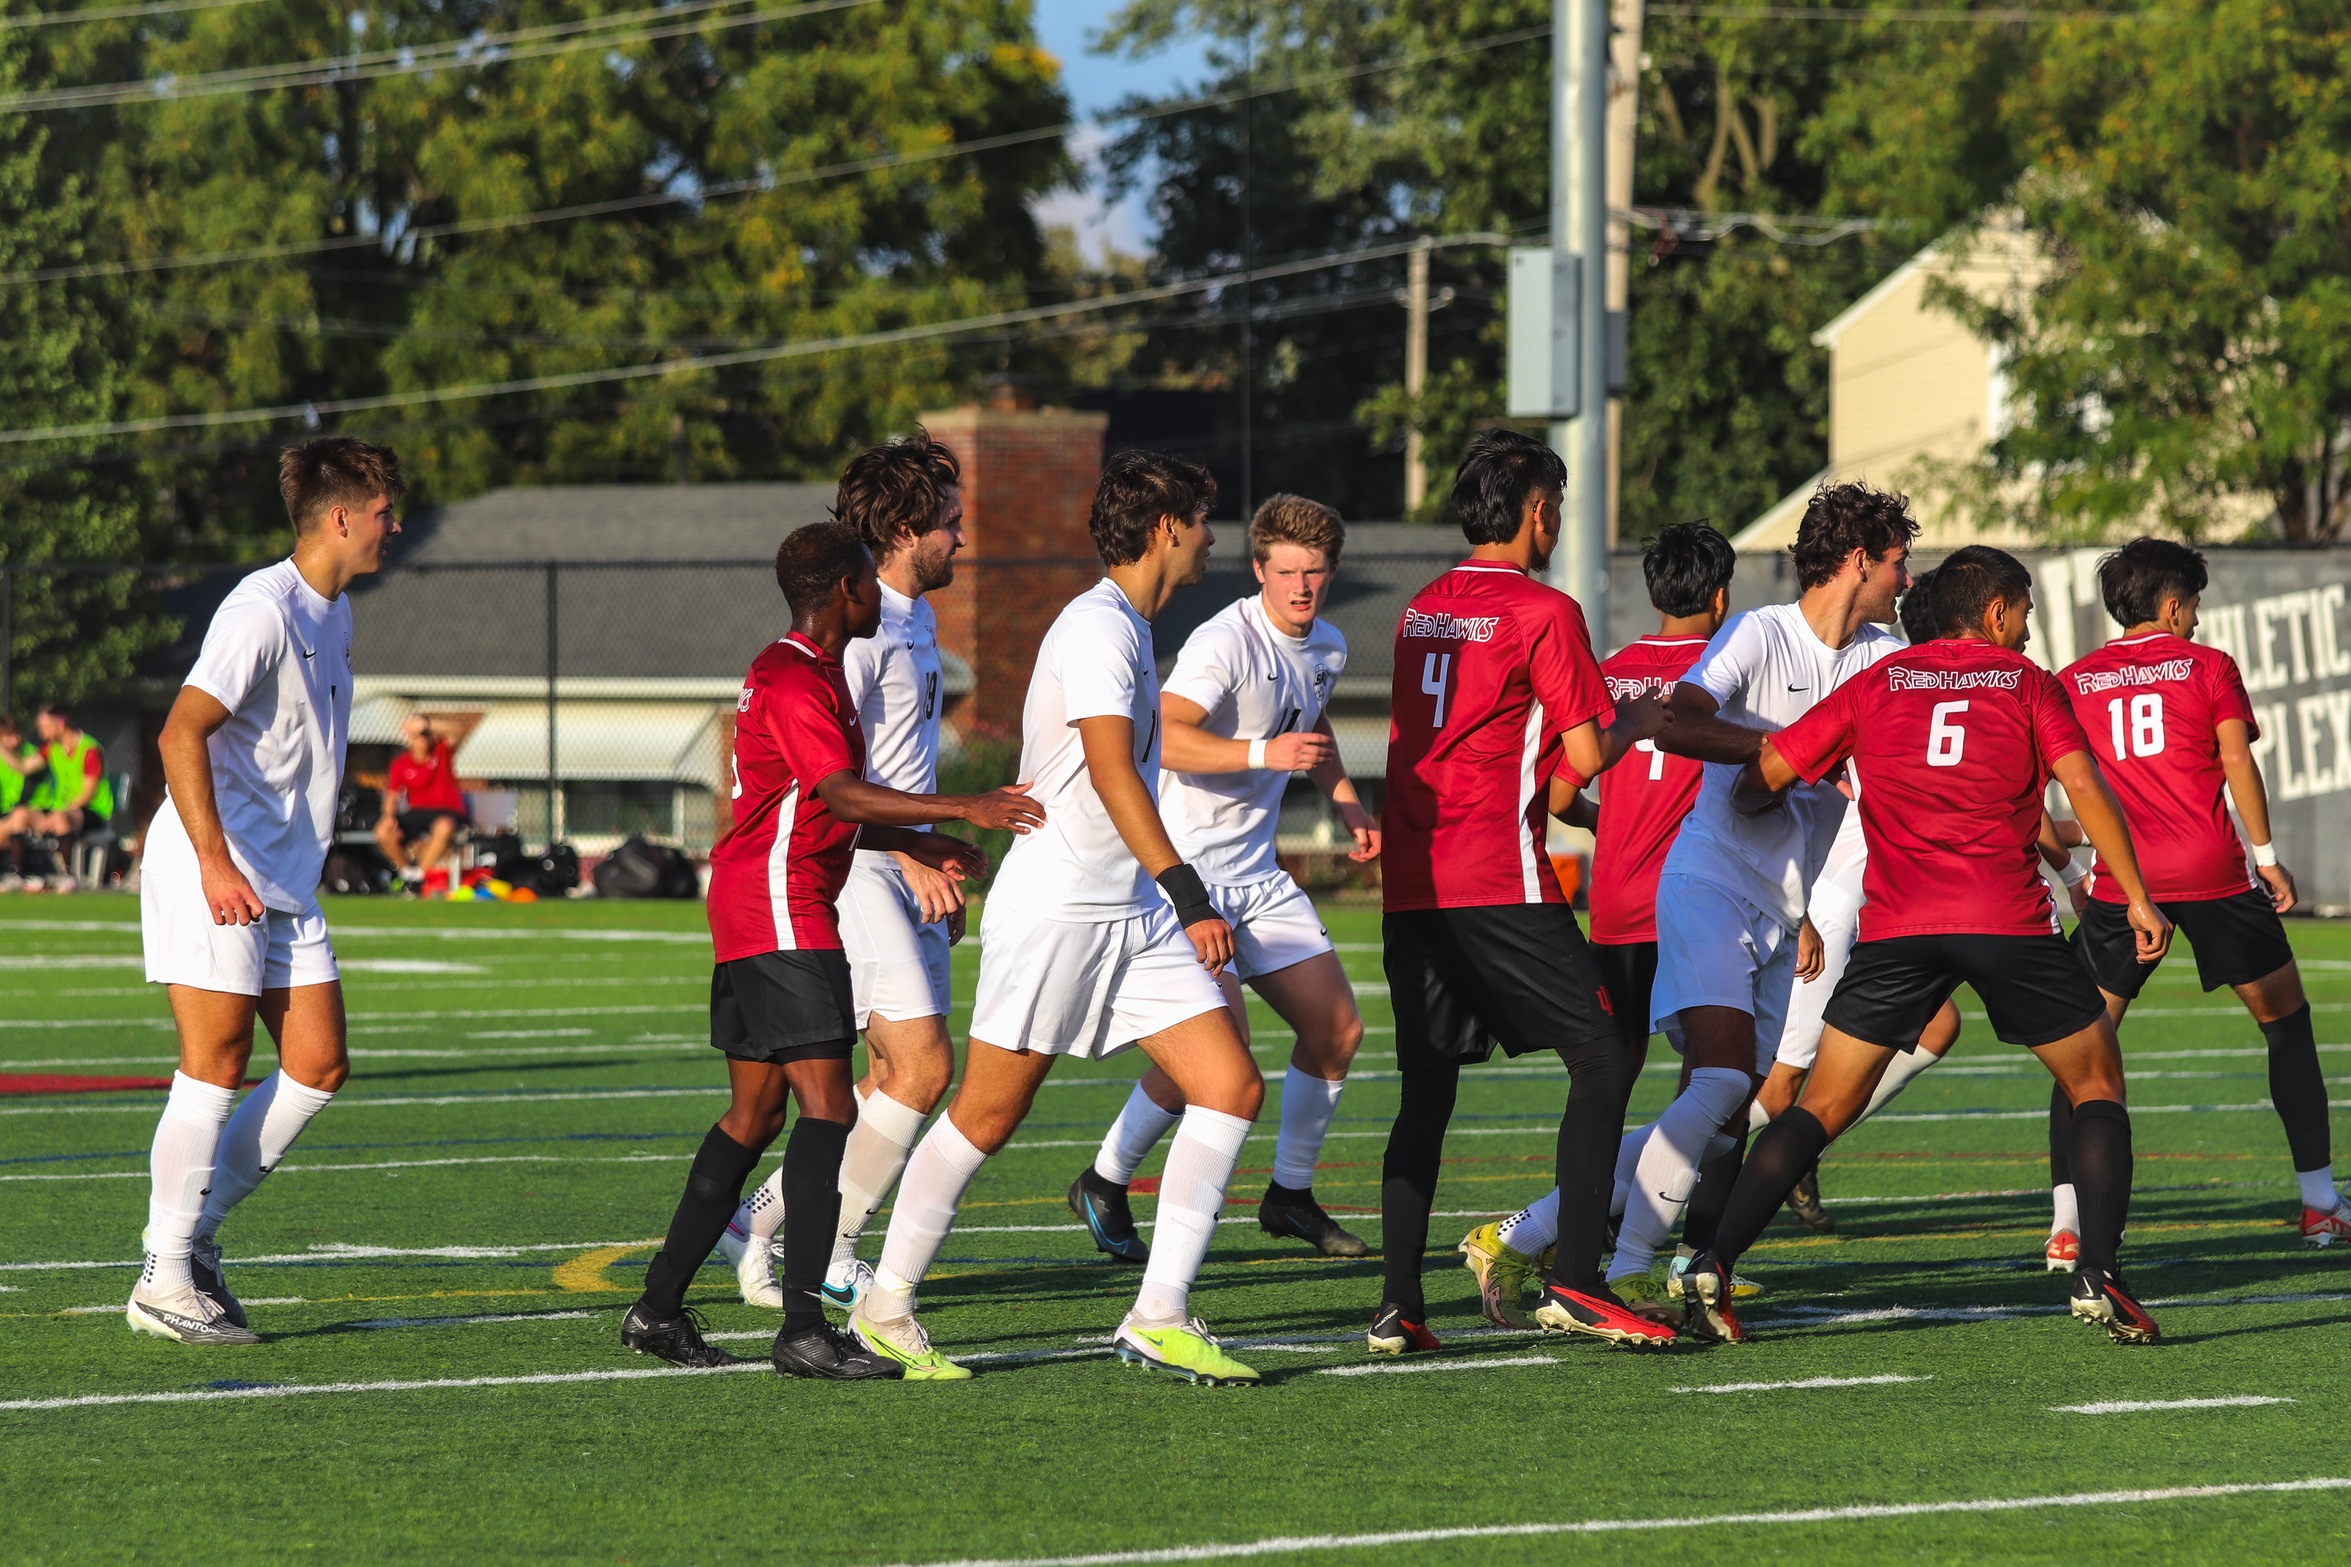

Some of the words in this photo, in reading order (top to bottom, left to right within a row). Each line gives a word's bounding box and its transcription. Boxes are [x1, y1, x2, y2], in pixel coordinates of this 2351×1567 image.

[1421, 652, 1451, 728] 4
[1926, 699, 1970, 767] 6
[2107, 693, 2166, 762] 18
